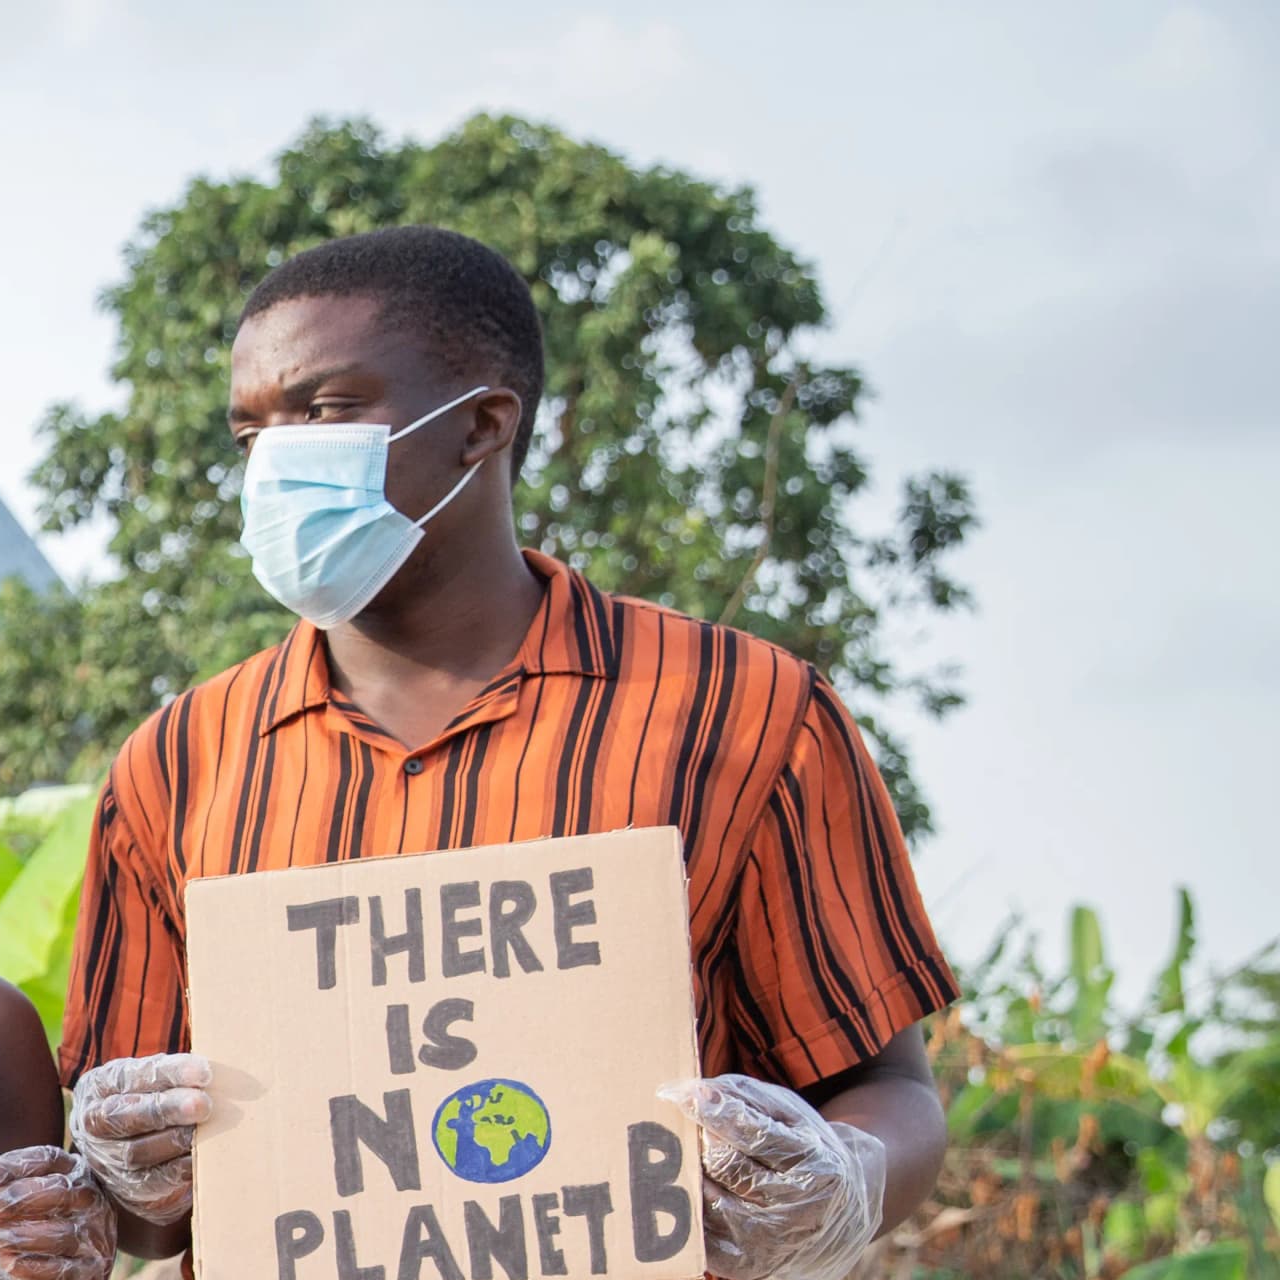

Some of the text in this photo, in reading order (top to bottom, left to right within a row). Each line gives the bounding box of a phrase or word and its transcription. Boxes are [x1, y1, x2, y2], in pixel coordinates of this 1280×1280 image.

[287, 868, 601, 989] THERE
[387, 999, 477, 1074] IS
[628, 1122, 691, 1262] B
